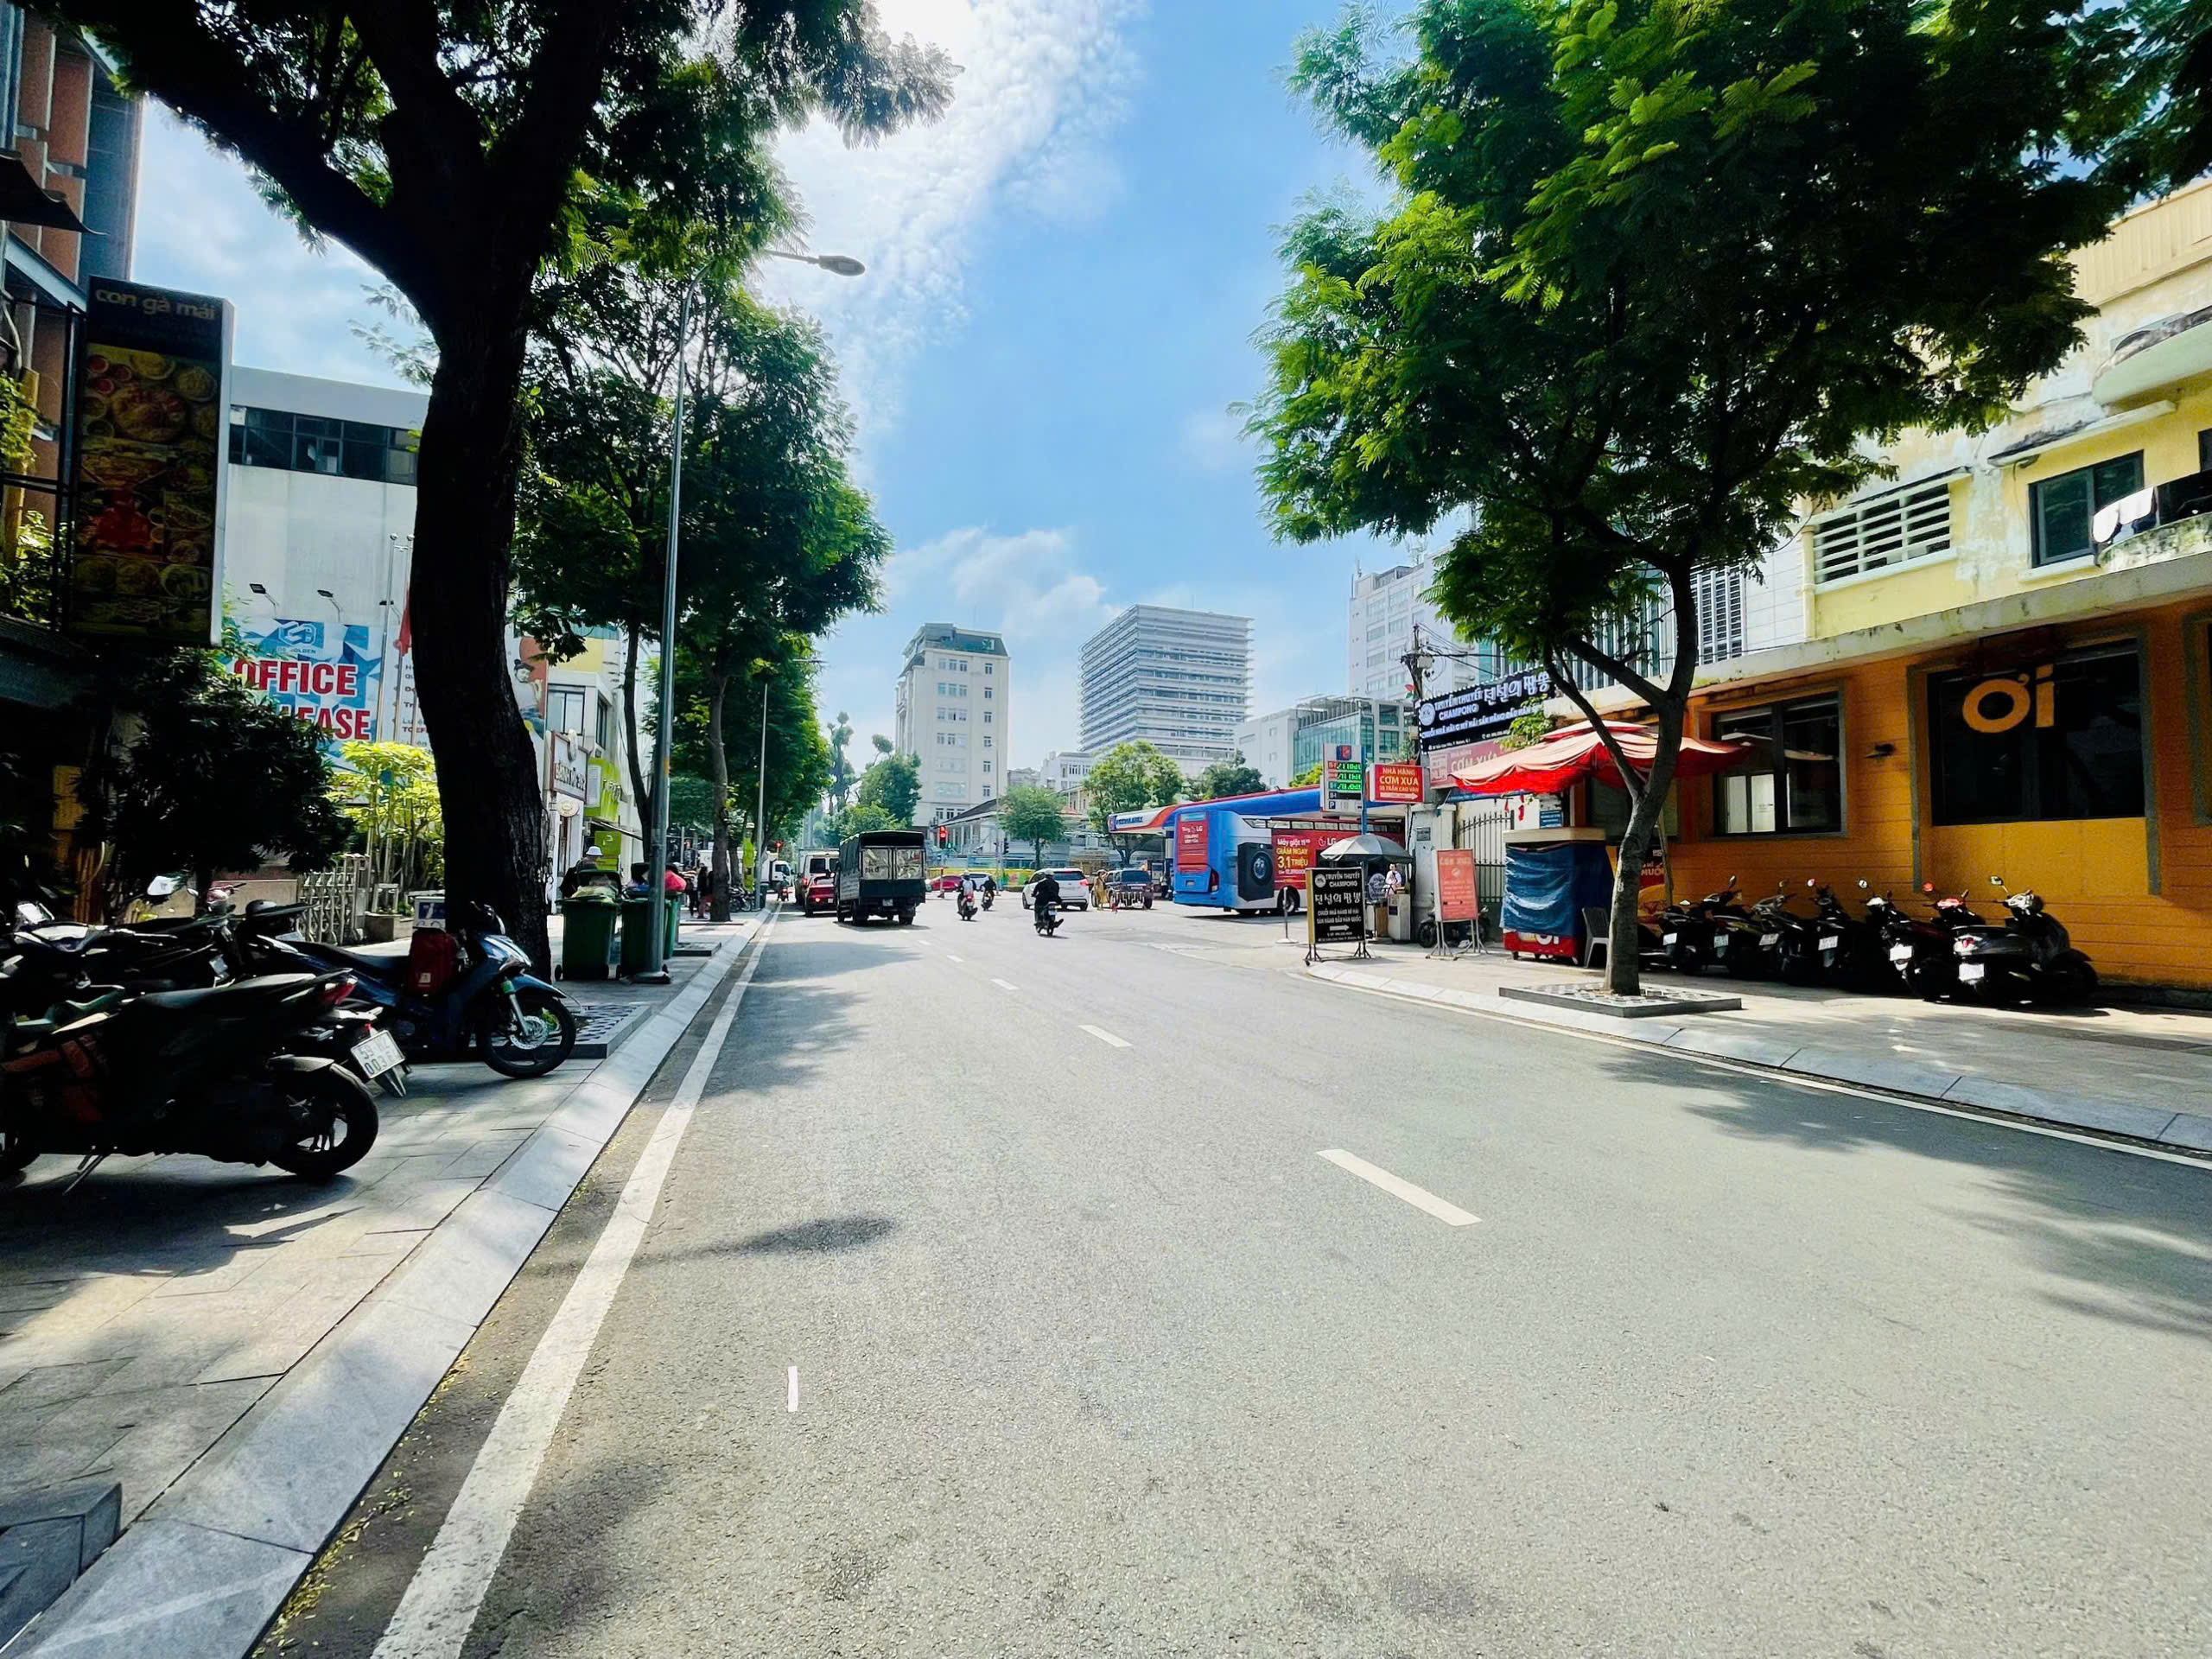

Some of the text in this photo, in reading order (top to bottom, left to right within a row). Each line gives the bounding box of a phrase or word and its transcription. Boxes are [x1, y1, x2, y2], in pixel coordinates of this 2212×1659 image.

[96, 289, 137, 308] con
[234, 659, 356, 696] OFFICE
[282, 706, 371, 741] EASE
[1439, 703, 1479, 721] CHAMPONG
